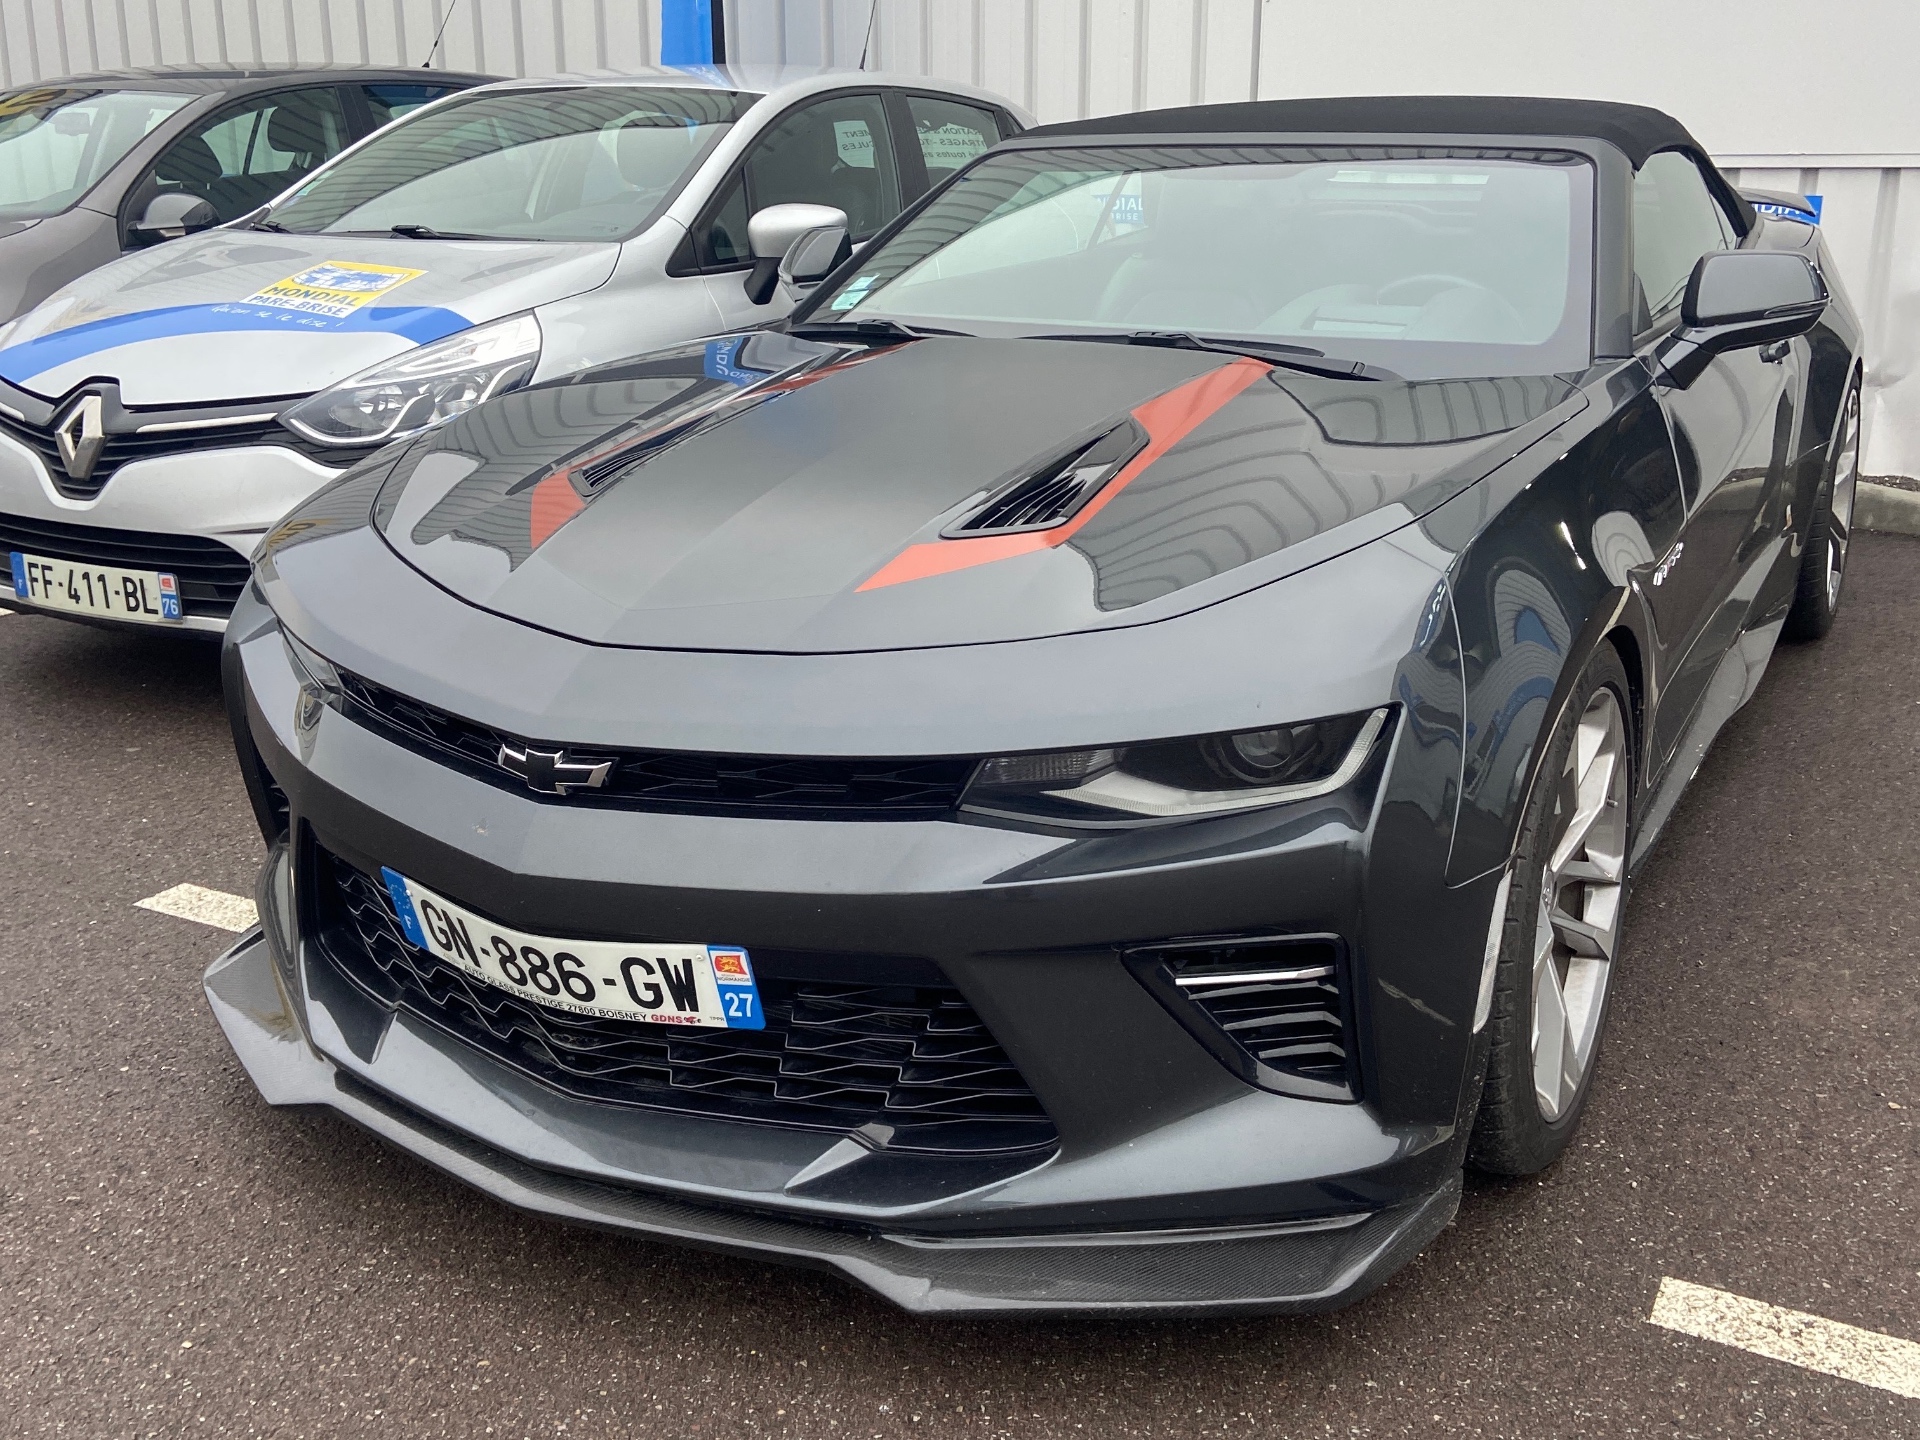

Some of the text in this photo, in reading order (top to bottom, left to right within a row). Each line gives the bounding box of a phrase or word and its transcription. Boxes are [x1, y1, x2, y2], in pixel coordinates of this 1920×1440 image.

[249, 295, 349, 316] PARE-BRISE
[264, 286, 362, 307] MONDIAL
[27, 562, 159, 615] FF-411-BL
[162, 598, 178, 615] 76
[404, 899, 700, 1013] F GN-886-GW
[464, 964, 683, 1024] AUTO GLASS PRESTIGE 27800 BOISNEY GDNS
[725, 992, 753, 1018] 27
